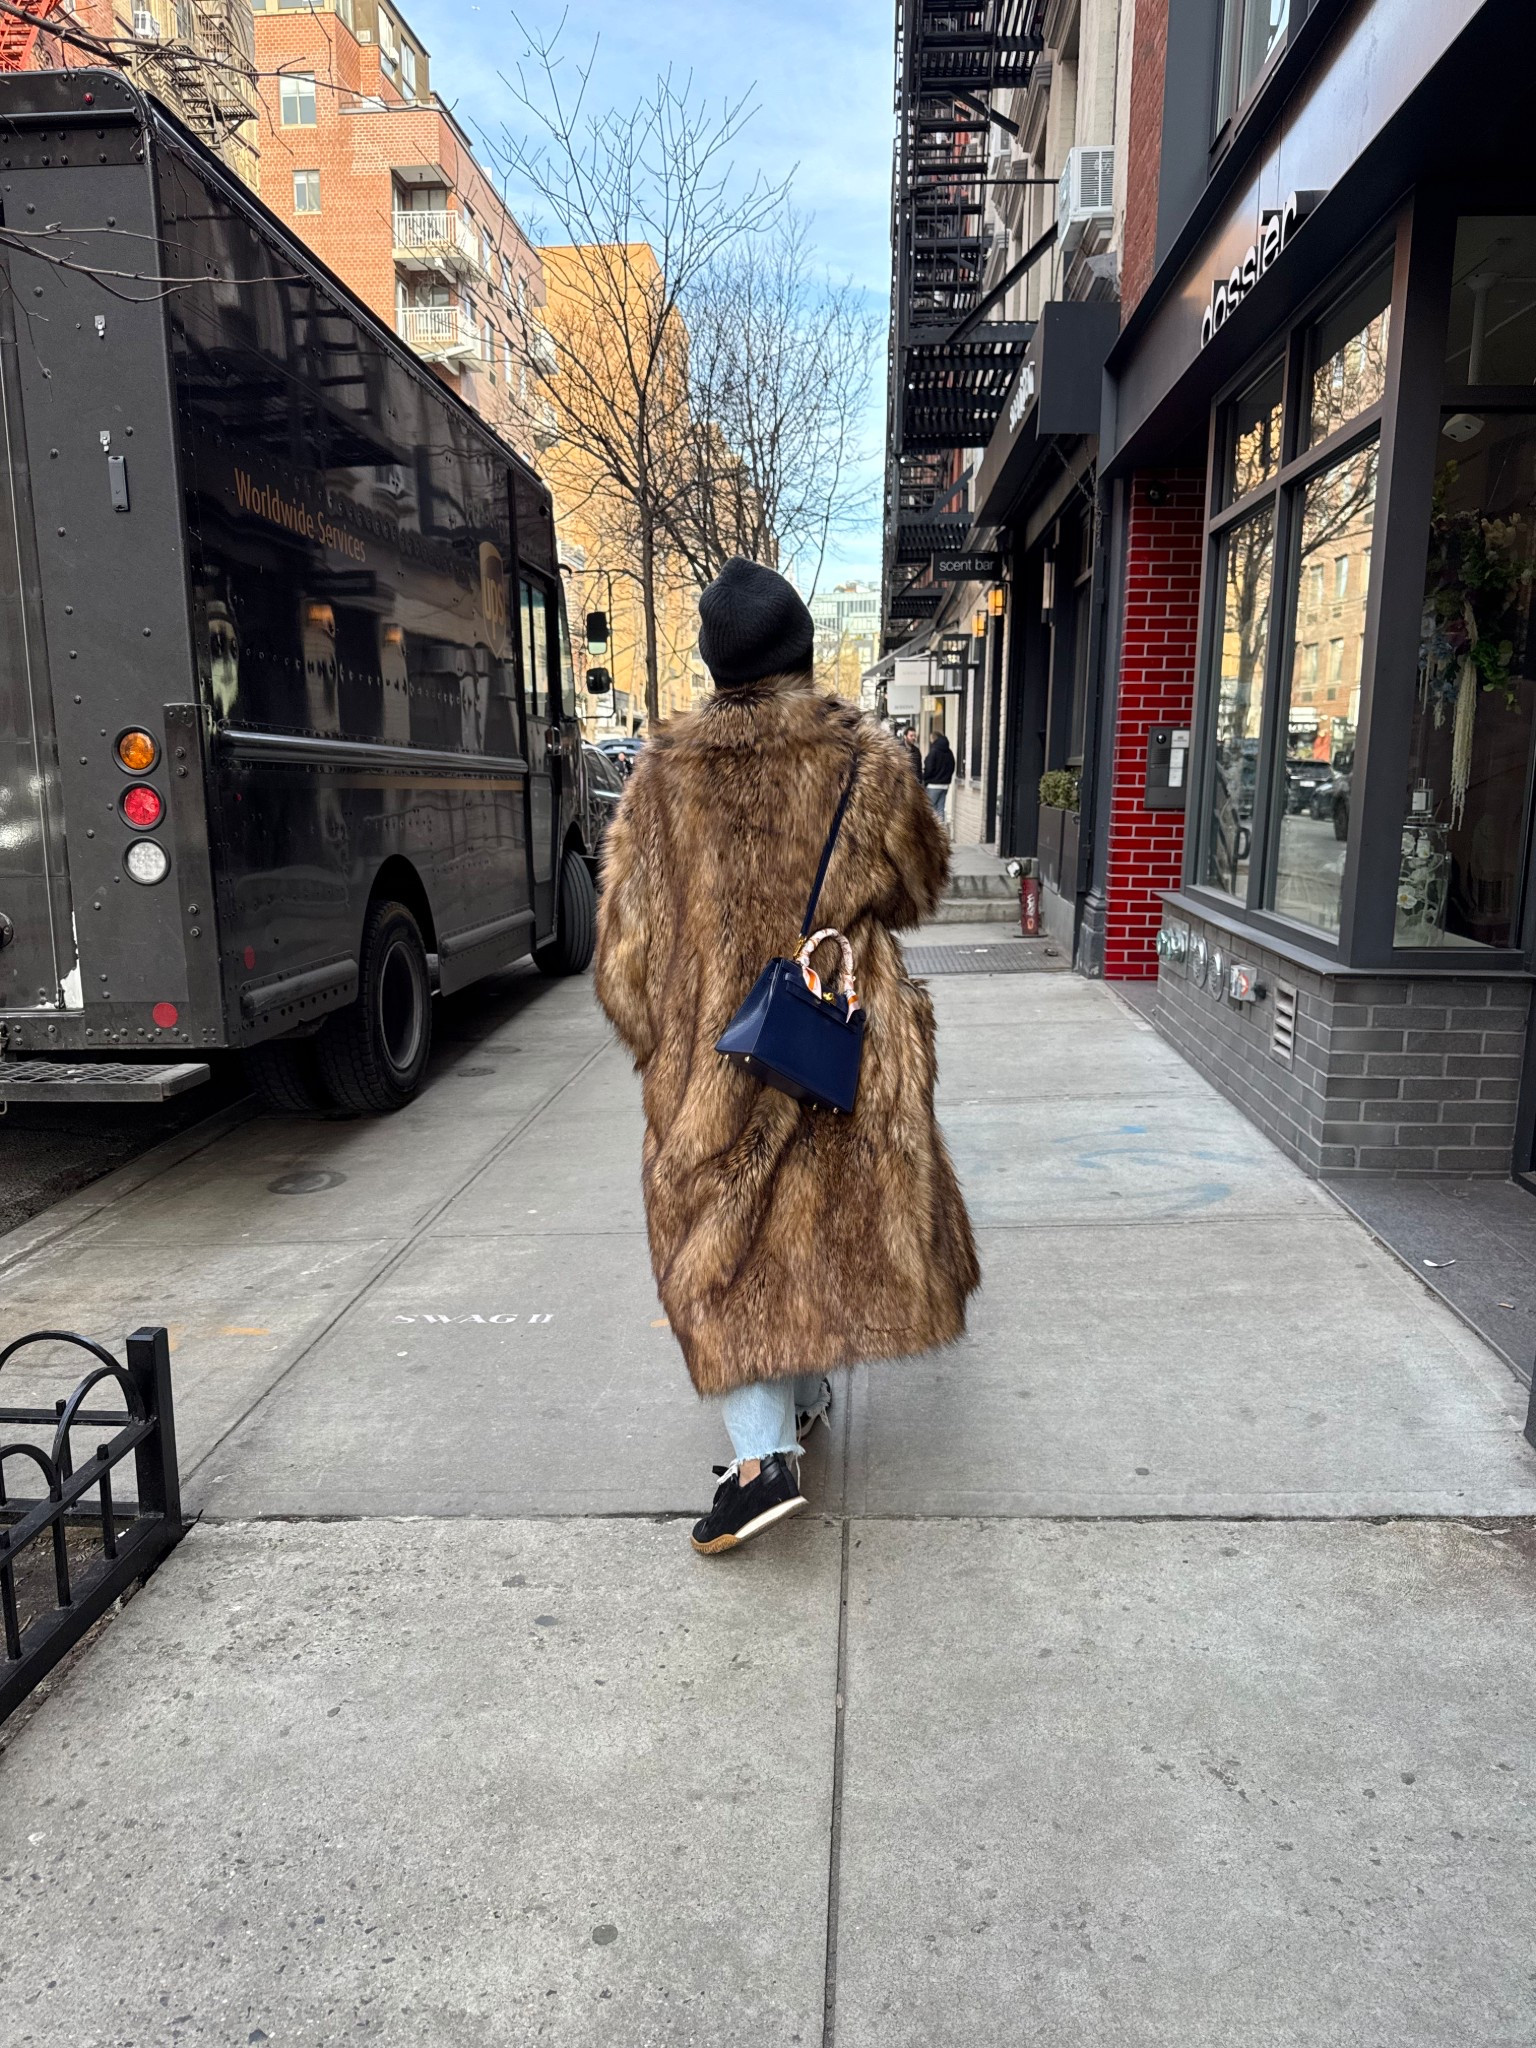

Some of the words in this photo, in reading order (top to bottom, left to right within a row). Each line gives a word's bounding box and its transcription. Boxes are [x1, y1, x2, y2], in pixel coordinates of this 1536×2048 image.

[1201, 190, 1297, 349] dossier
[234, 467, 314, 539] Worldwide
[317, 511, 366, 562] Services
[939, 559, 971, 571] scent
[975, 558, 994, 571] bar
[483, 577, 506, 640] ups
[391, 1314, 519, 1324] SWAG
